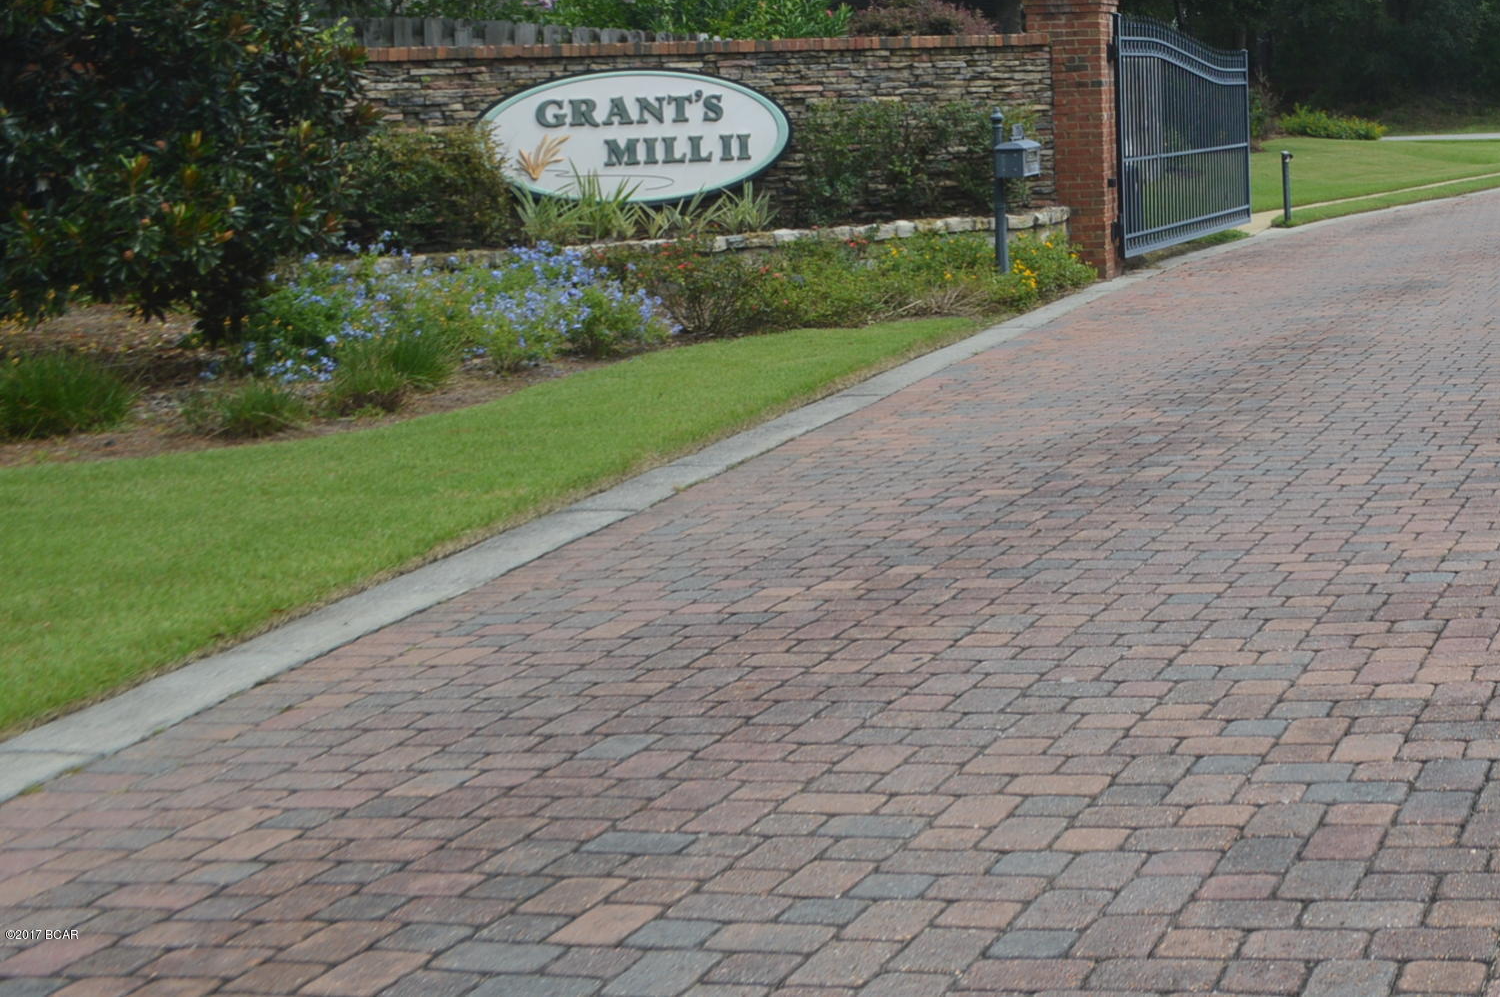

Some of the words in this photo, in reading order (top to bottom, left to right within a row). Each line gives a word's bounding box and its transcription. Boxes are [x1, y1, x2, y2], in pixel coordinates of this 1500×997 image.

[535, 89, 724, 128] GRANT'S
[603, 135, 713, 167] MILL
[719, 133, 752, 161] II
